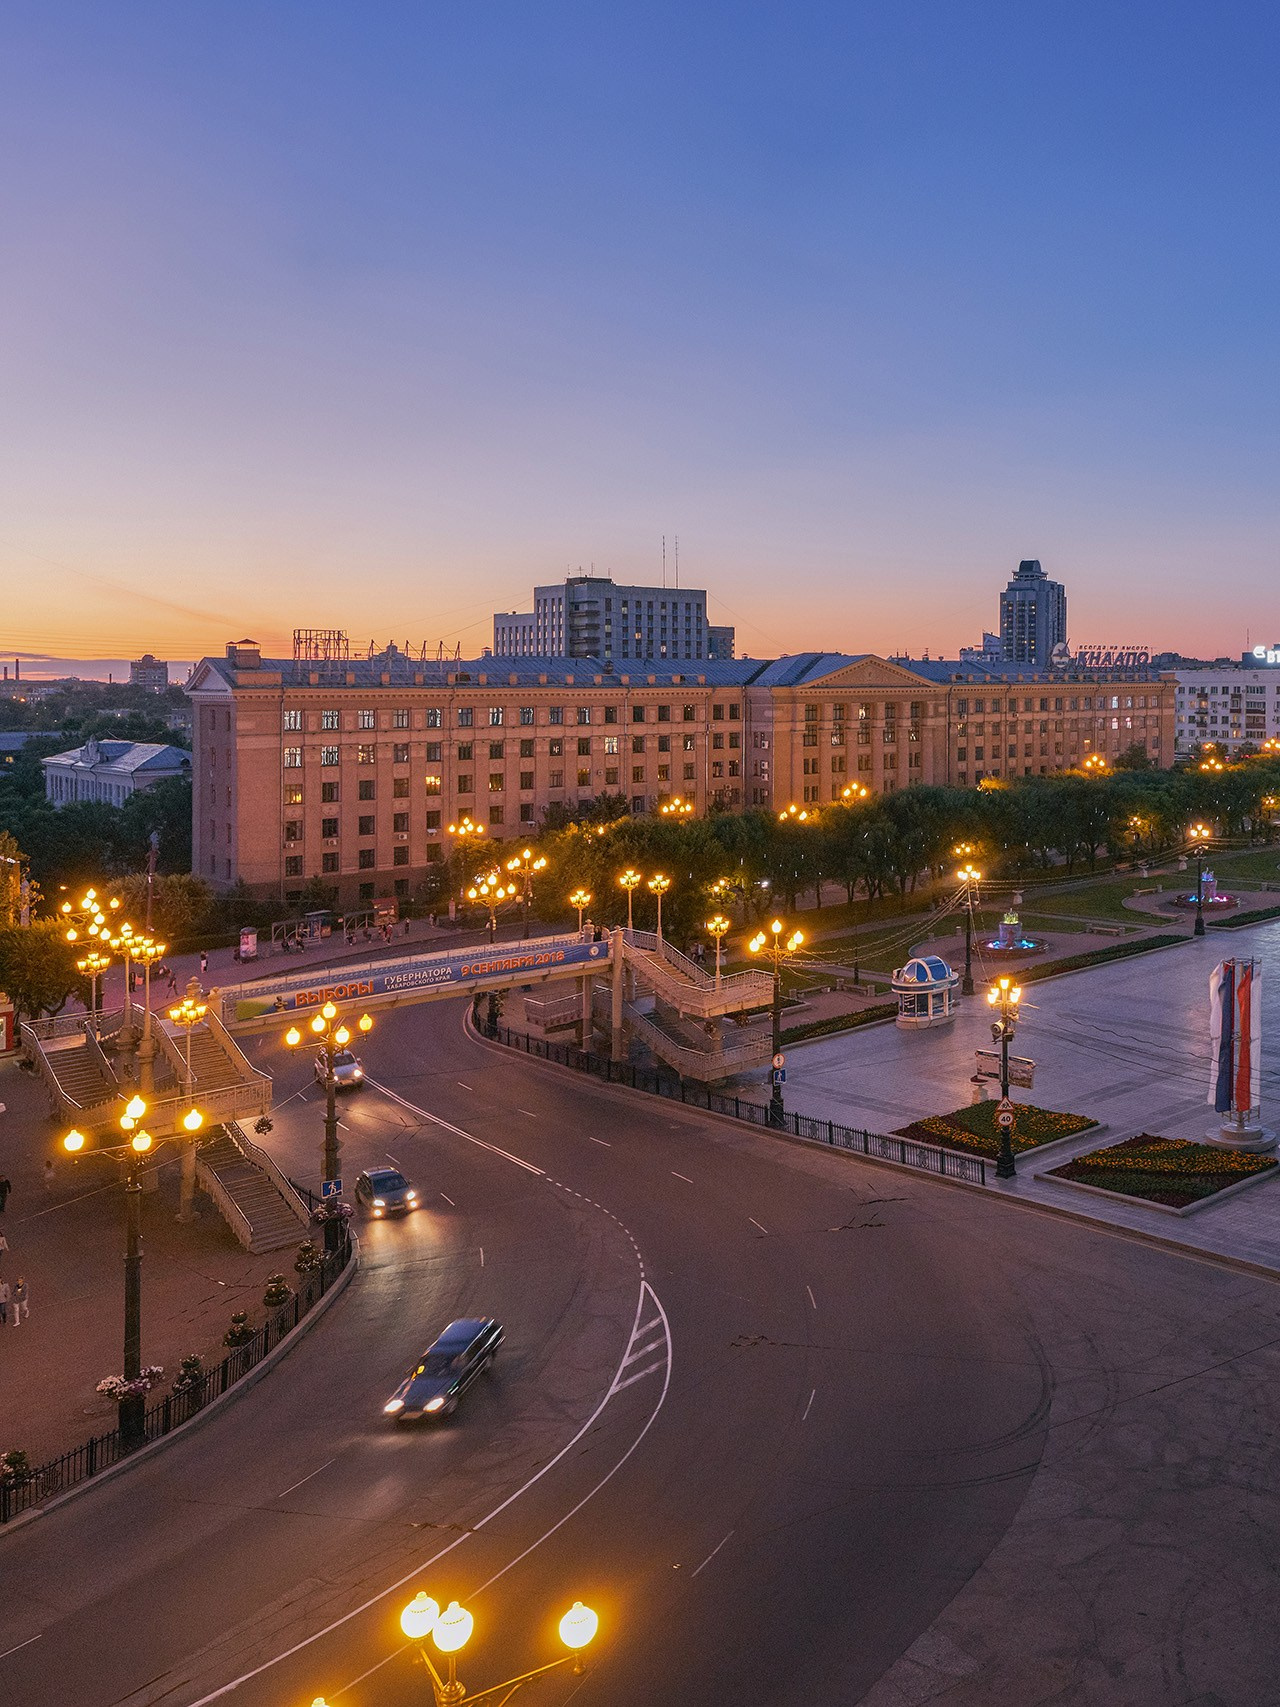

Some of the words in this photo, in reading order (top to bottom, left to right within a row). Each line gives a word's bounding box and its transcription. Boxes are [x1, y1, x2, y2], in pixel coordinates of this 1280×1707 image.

[1076, 651, 1149, 667] КНААПО
[461, 965, 470, 977] 9
[470, 955, 535, 975] СЕНТЯБРЯ
[535, 950, 565, 965] 2018
[384, 967, 452, 985] ГУБЕРНАТОРА
[386, 977, 435, 990] ХАБАРОВСКОГО
[435, 975, 451, 983] КРАЯ
[295, 980, 374, 1006] ВЫБОРЫ
